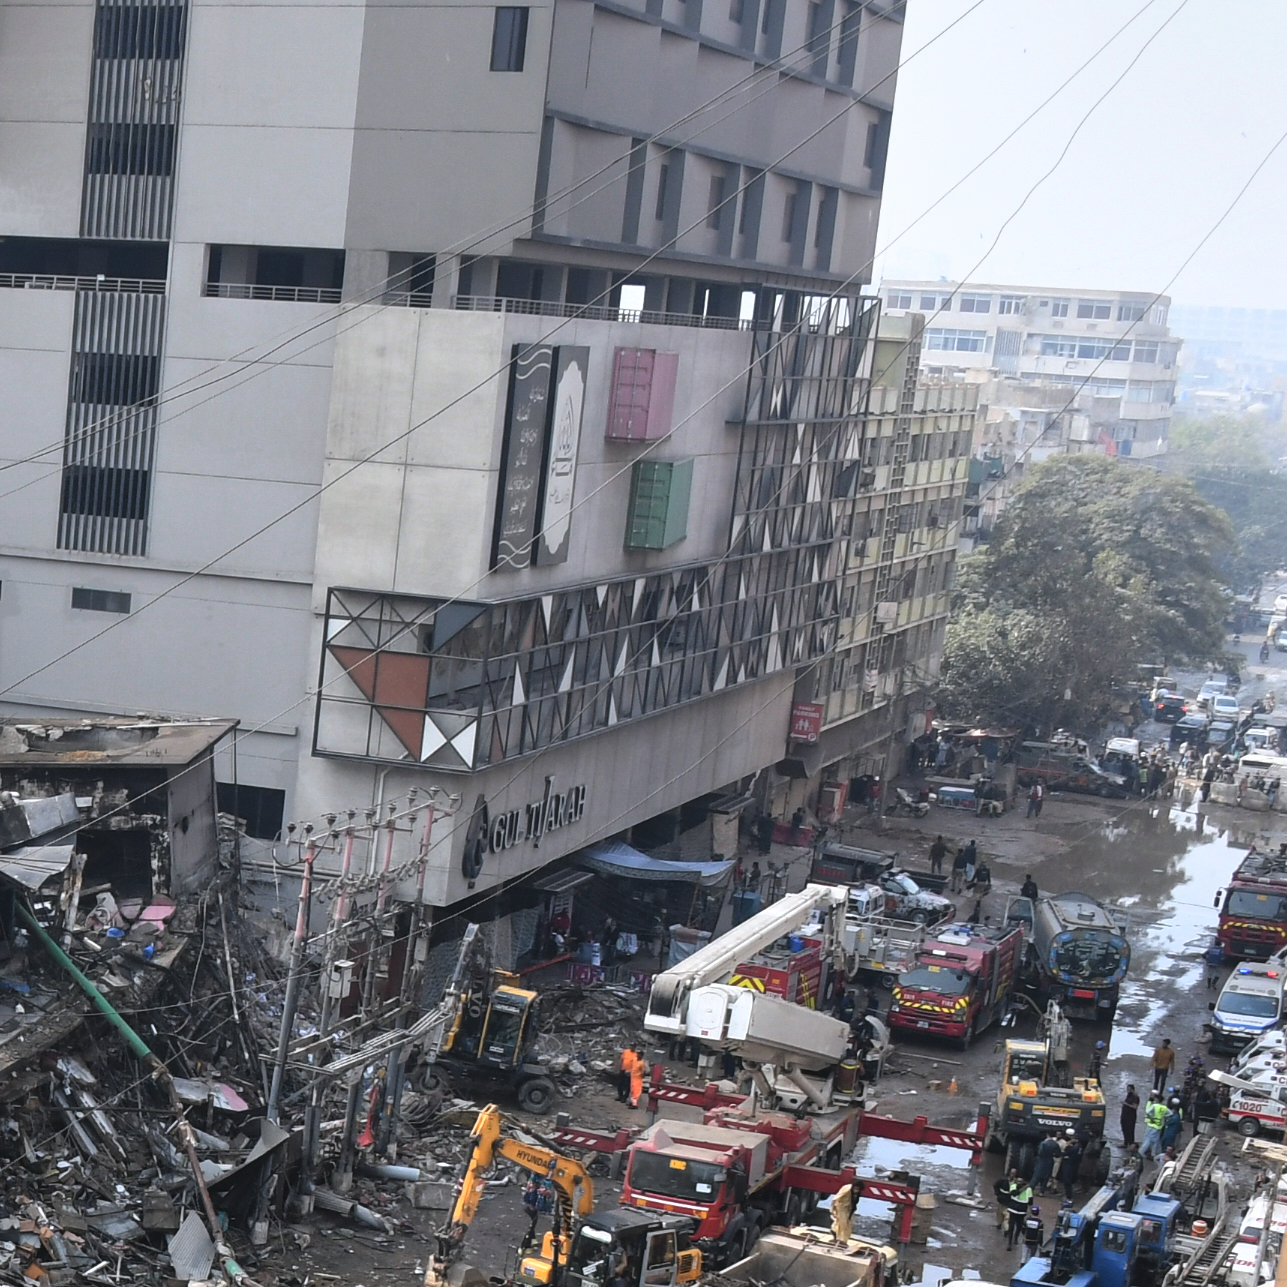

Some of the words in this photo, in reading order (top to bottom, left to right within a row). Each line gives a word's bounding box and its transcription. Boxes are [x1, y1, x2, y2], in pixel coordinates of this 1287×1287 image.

[489, 809, 524, 853] GUL
[1239, 1101, 1262, 1113] 1020
[1037, 1118, 1073, 1127] VOLVO
[516, 1150, 556, 1171] HYUNDA
